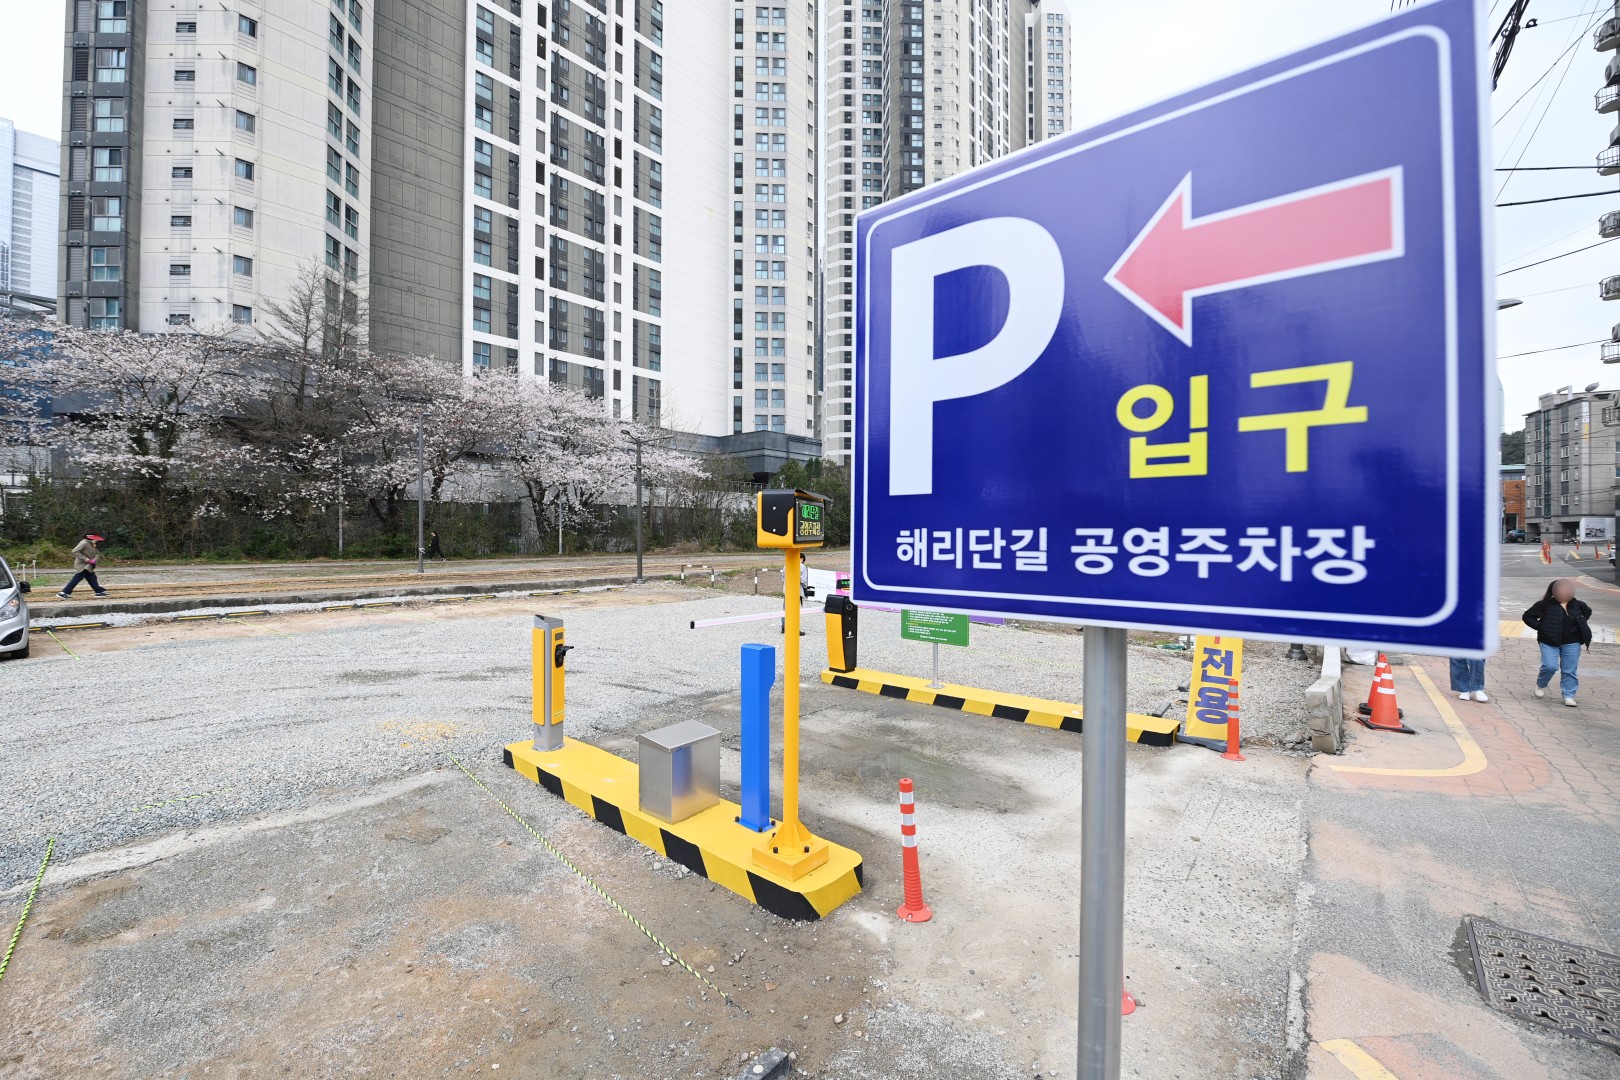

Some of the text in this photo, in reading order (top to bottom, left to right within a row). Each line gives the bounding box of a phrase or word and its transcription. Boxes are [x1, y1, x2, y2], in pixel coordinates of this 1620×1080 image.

[889, 217, 1065, 497] P
[895, 525, 1376, 585] 해리단길 공영주차장
[1195, 647, 1234, 725] 전용
